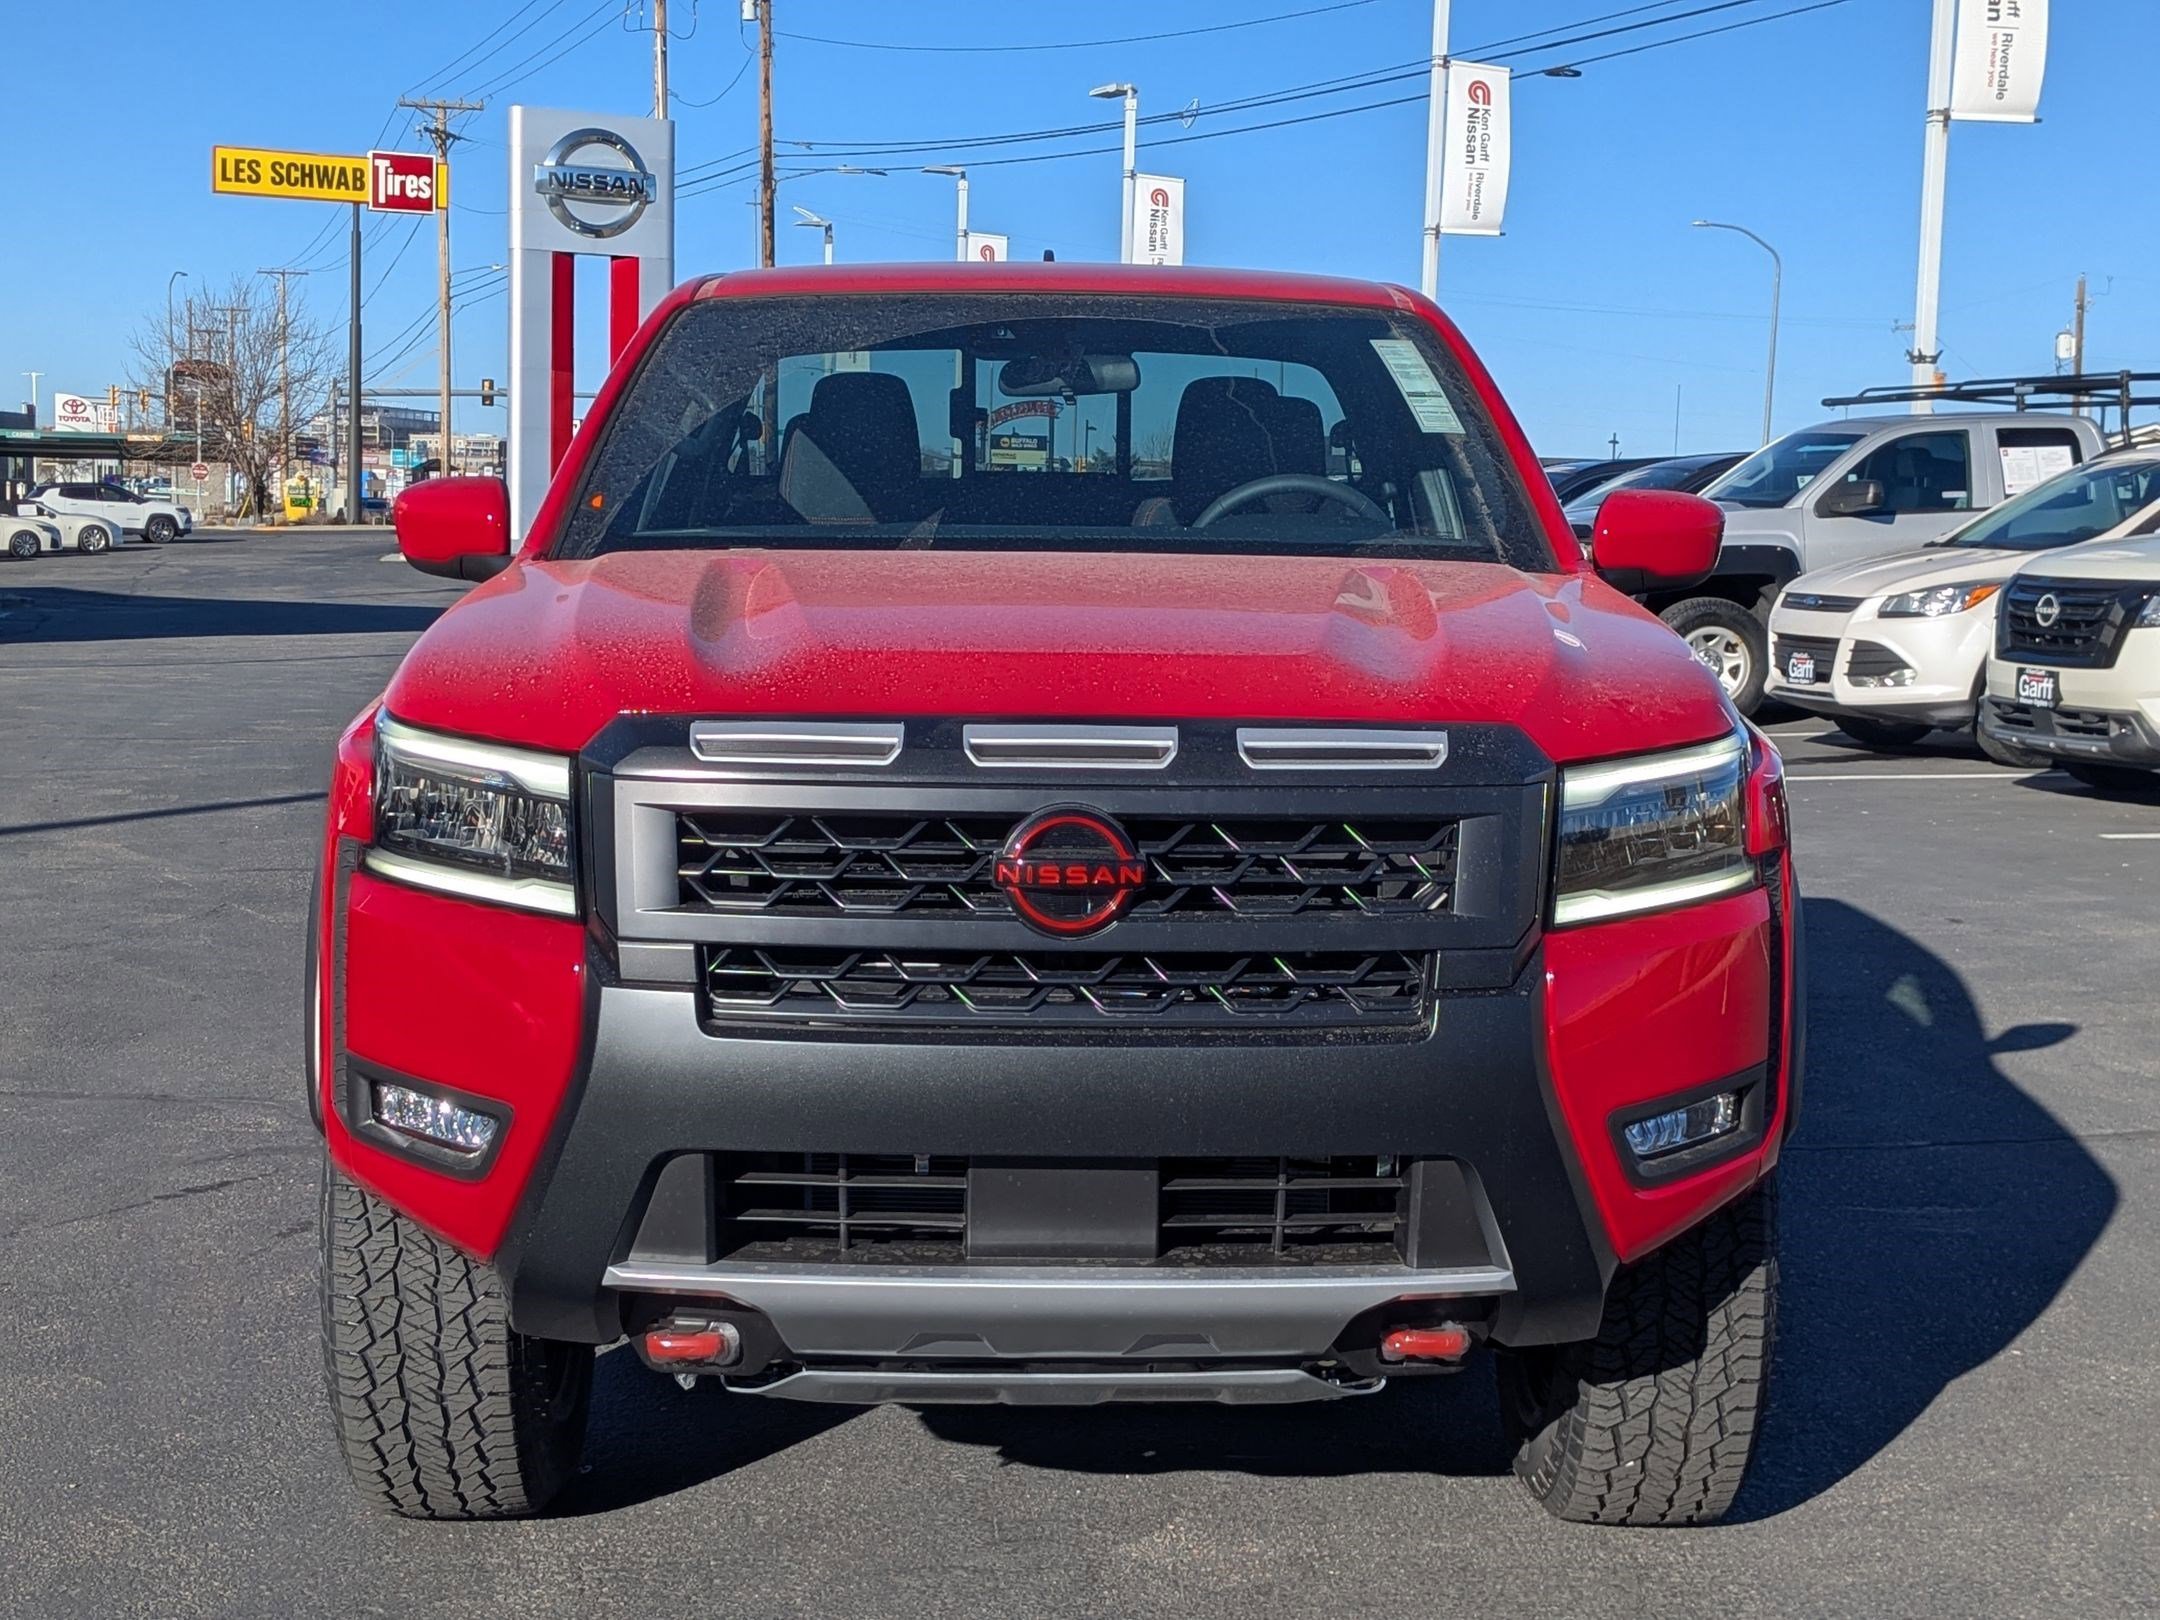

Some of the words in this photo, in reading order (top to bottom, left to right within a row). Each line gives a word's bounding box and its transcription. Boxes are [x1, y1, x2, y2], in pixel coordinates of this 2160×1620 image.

[2006, 0, 2020, 18] rff
[1991, 33, 1998, 46] we
[1989, 48, 1998, 68] hear
[1995, 33, 2014, 100] Riverdale
[1987, 70, 1995, 88] you
[1480, 108, 1491, 130] Ken
[1465, 107, 1480, 165] Nissan
[1480, 133, 1491, 162] Garff
[221, 157, 262, 184] LES
[270, 160, 366, 192] SCHWAB
[374, 158, 432, 204] Tires
[548, 171, 645, 194] NISSAN
[1472, 172, 1485, 221] Riverdale
[1160, 209, 1169, 226] Ken
[1148, 208, 1160, 252] Nissan
[1160, 228, 1168, 250] Garff
[58, 415, 91, 423] TOYOTA
[1789, 658, 1814, 678] Garff
[2019, 674, 2053, 700] Garff
[996, 863, 1145, 885] NISSAN
